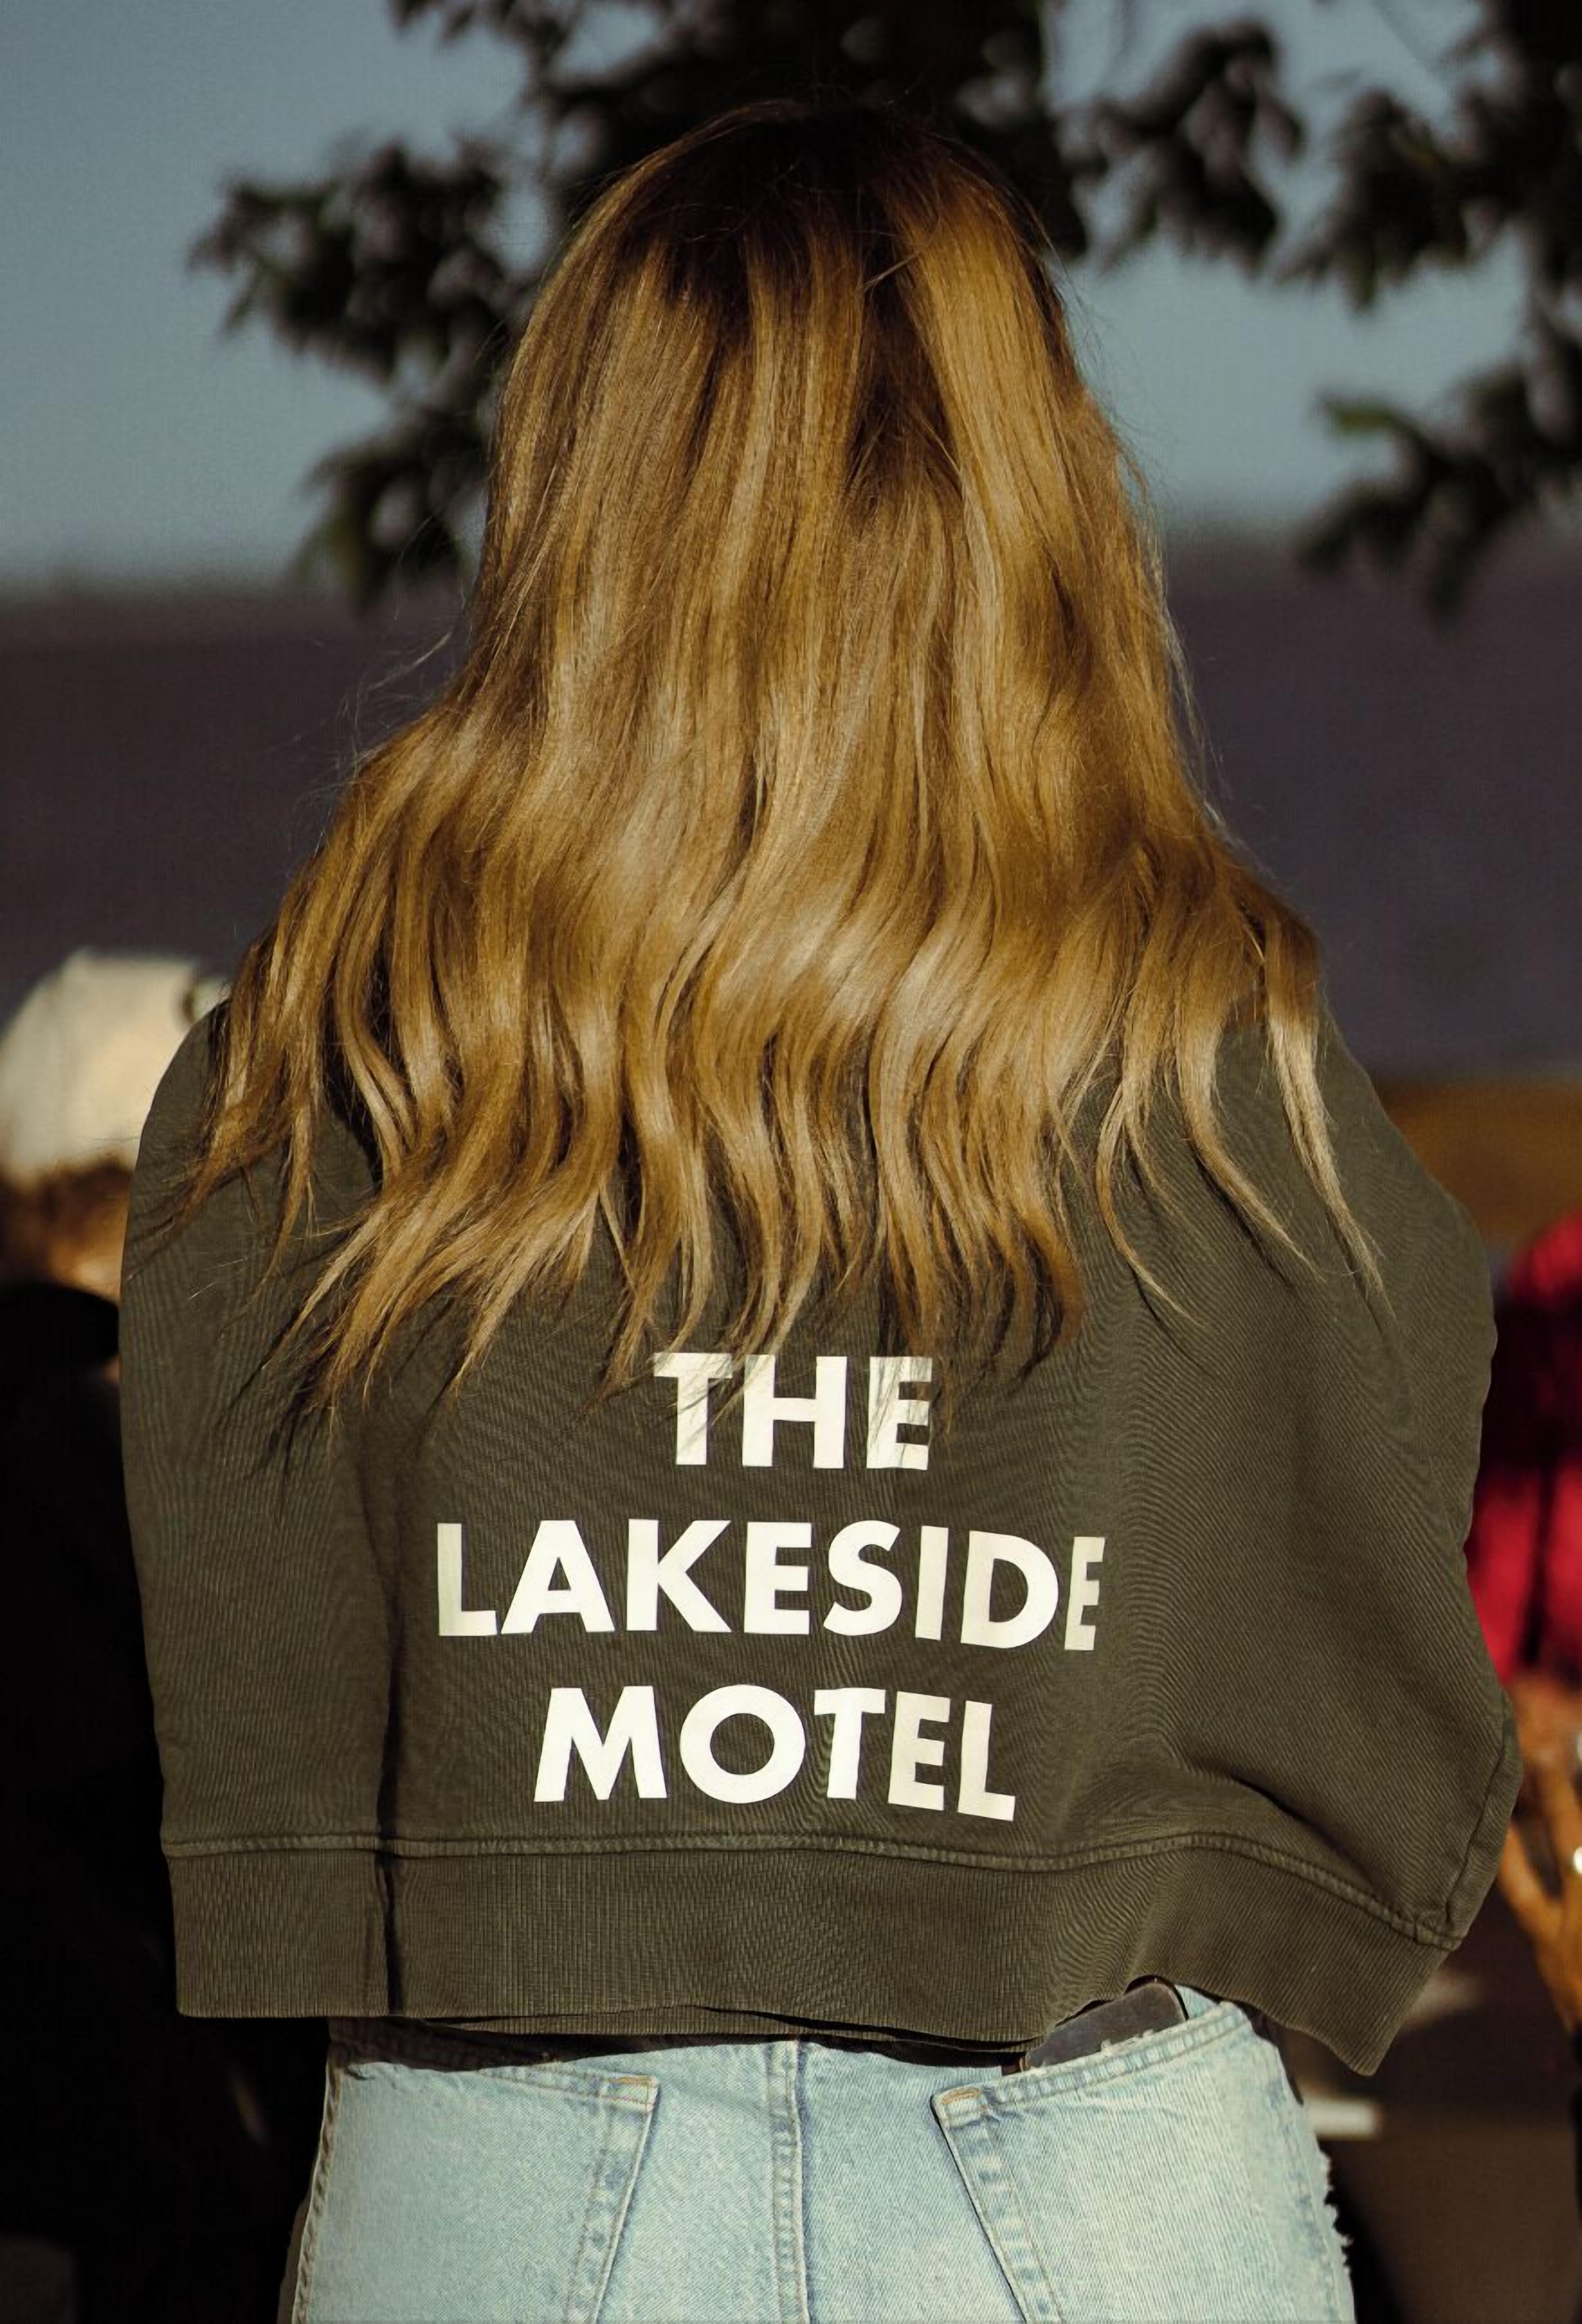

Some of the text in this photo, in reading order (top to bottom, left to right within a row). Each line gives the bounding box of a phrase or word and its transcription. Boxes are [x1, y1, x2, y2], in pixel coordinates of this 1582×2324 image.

[653, 1352, 933, 1471] THE
[437, 1519, 1106, 1651] LAKESIDE
[534, 1684, 1016, 1822] MOTEL
